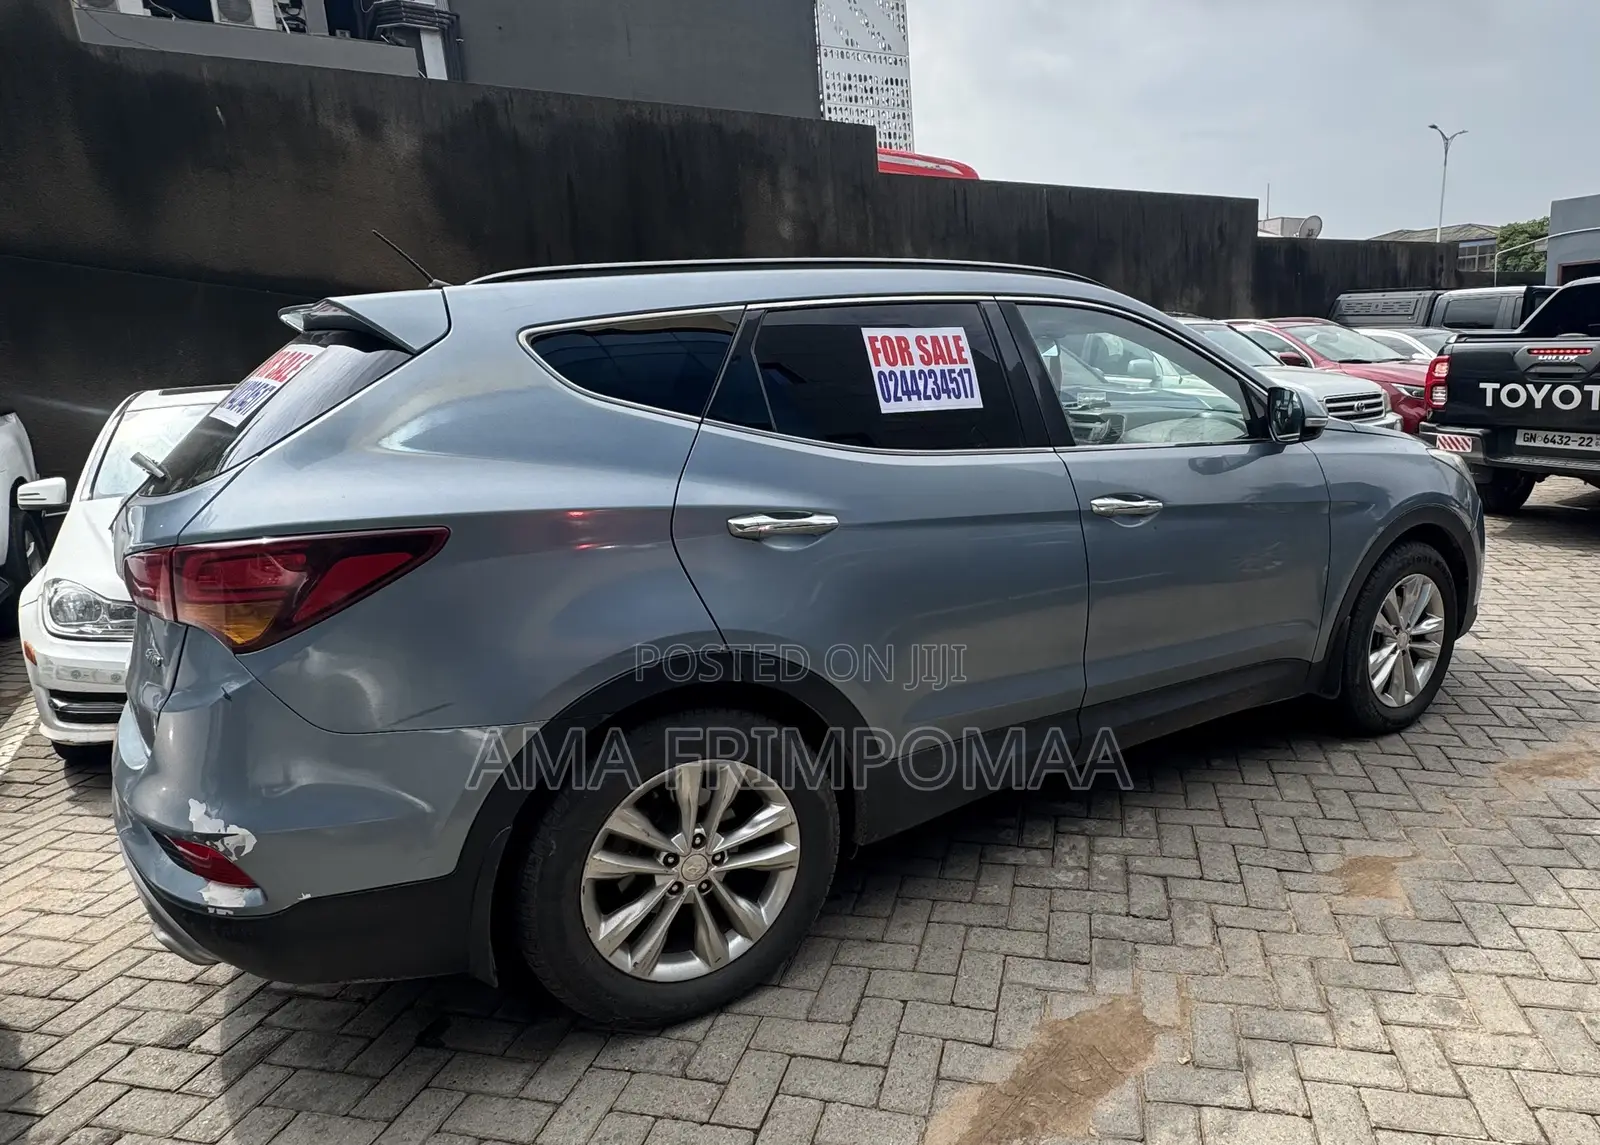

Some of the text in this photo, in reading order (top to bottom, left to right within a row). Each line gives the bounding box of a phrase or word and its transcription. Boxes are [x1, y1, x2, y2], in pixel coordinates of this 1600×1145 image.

[867, 335, 969, 367] FOR SALE
[877, 368, 975, 403] 0244234517
[1523, 432, 1537, 443] GN
[1543, 434, 1594, 447] 6432-22
